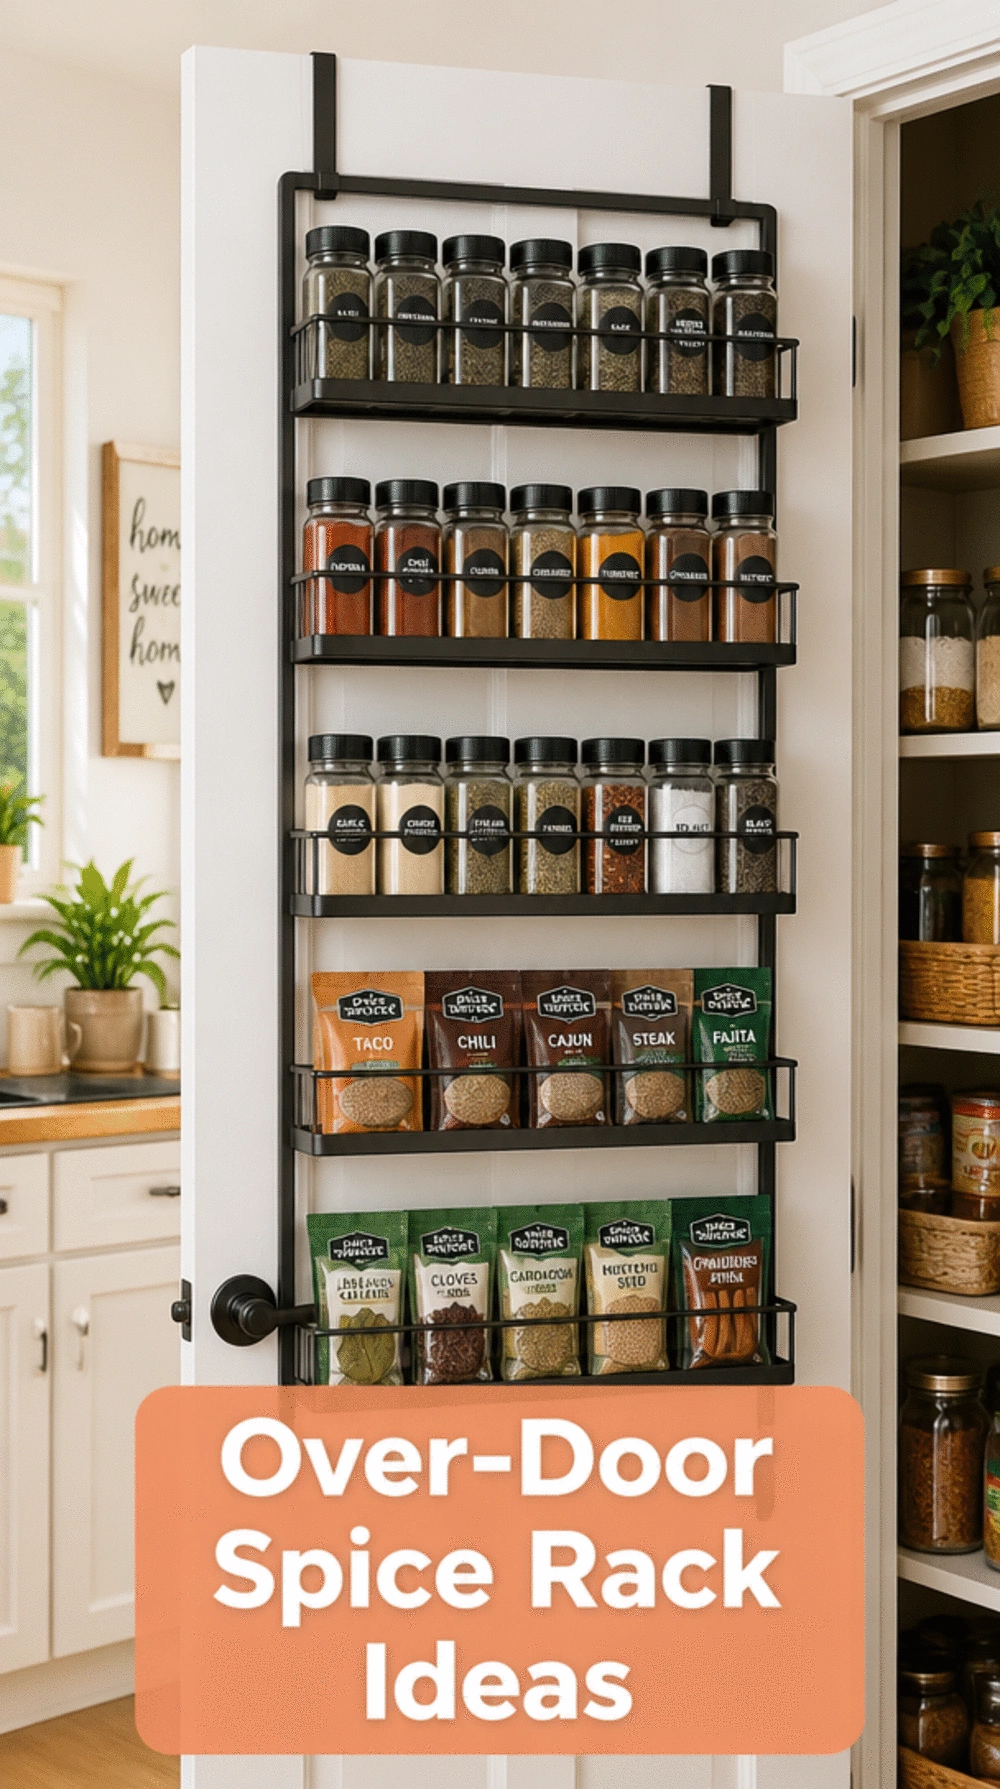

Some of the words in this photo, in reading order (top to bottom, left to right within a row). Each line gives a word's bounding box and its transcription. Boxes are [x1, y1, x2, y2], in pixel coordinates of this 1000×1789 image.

[129, 497, 181, 553] hom
[129, 572, 181, 613] swee
[129, 615, 181, 666] hom
[353, 1036, 394, 1051] TACO
[457, 1035, 496, 1050] CHILI
[548, 1033, 593, 1048] CAJUN
[632, 1031, 676, 1046] STEAK
[712, 1029, 757, 1045] FAJITA
[431, 1272, 478, 1287] CLOVES
